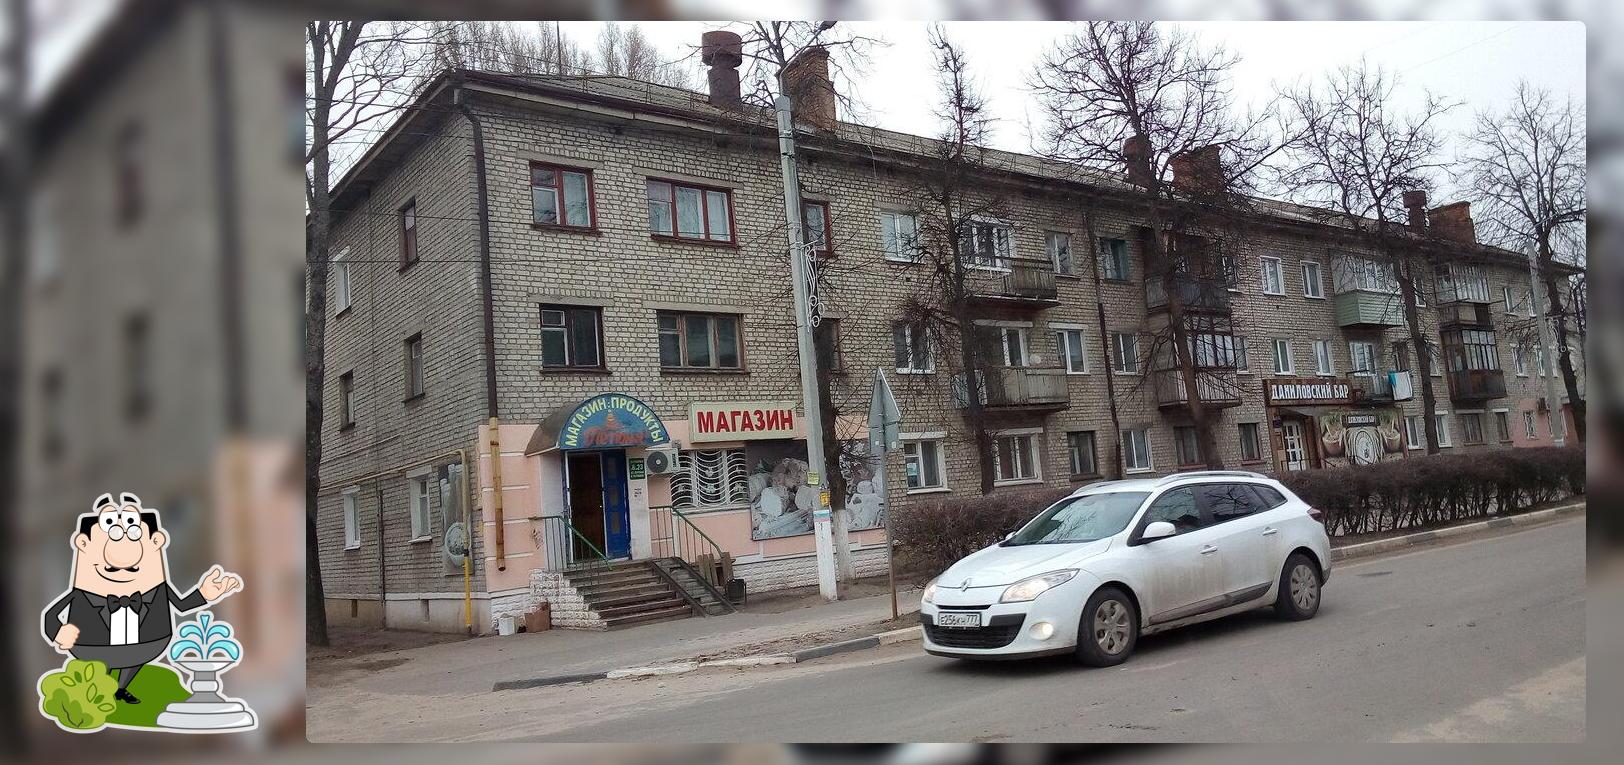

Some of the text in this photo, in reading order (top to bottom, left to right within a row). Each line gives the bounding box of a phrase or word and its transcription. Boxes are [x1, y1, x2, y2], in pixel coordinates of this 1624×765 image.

[1271, 382, 1349, 400] ДАНИЛОВСКИЙ БАР
[611, 397, 664, 442] ПРОДУКТЫ
[697, 409, 794, 433] МАГАЗИН
